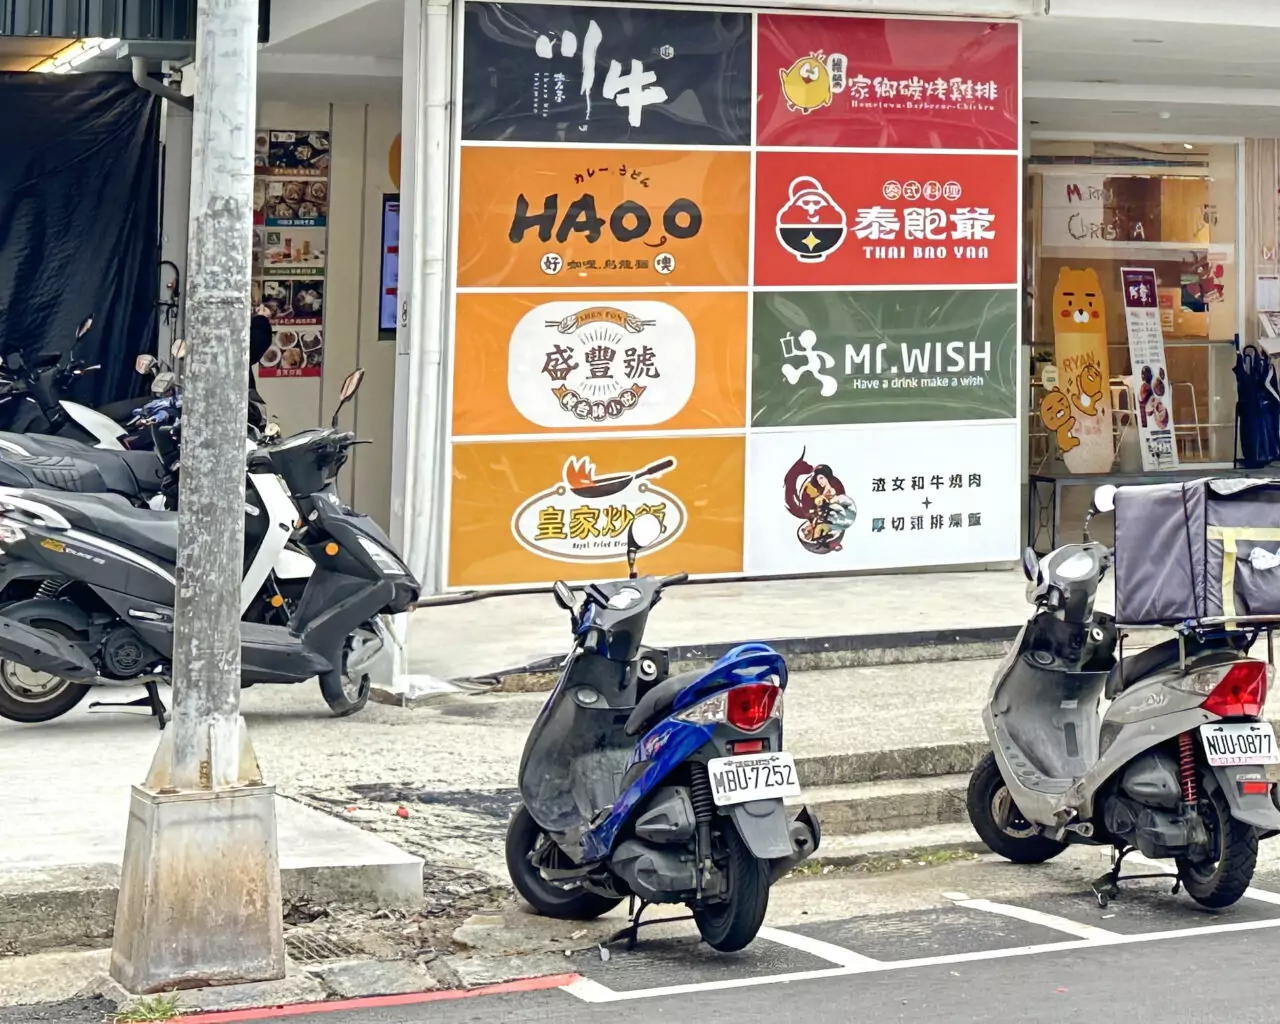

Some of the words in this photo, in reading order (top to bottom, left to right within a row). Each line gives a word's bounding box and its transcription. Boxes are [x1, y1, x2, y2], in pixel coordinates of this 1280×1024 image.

[848, 74, 999, 102] 家鄉碳烤雞排
[850, 206, 996, 241] 泰飽爺
[862, 246, 906, 259] THAI
[913, 246, 947, 259] BAO
[541, 344, 661, 381] 盛豐號
[853, 378, 879, 389] Have
[882, 380, 889, 389] a
[891, 377, 918, 388] drink
[921, 377, 948, 388] make
[951, 377, 958, 386] a
[960, 376, 984, 386] wish
[872, 473, 981, 492] 渣女和牛燒肉
